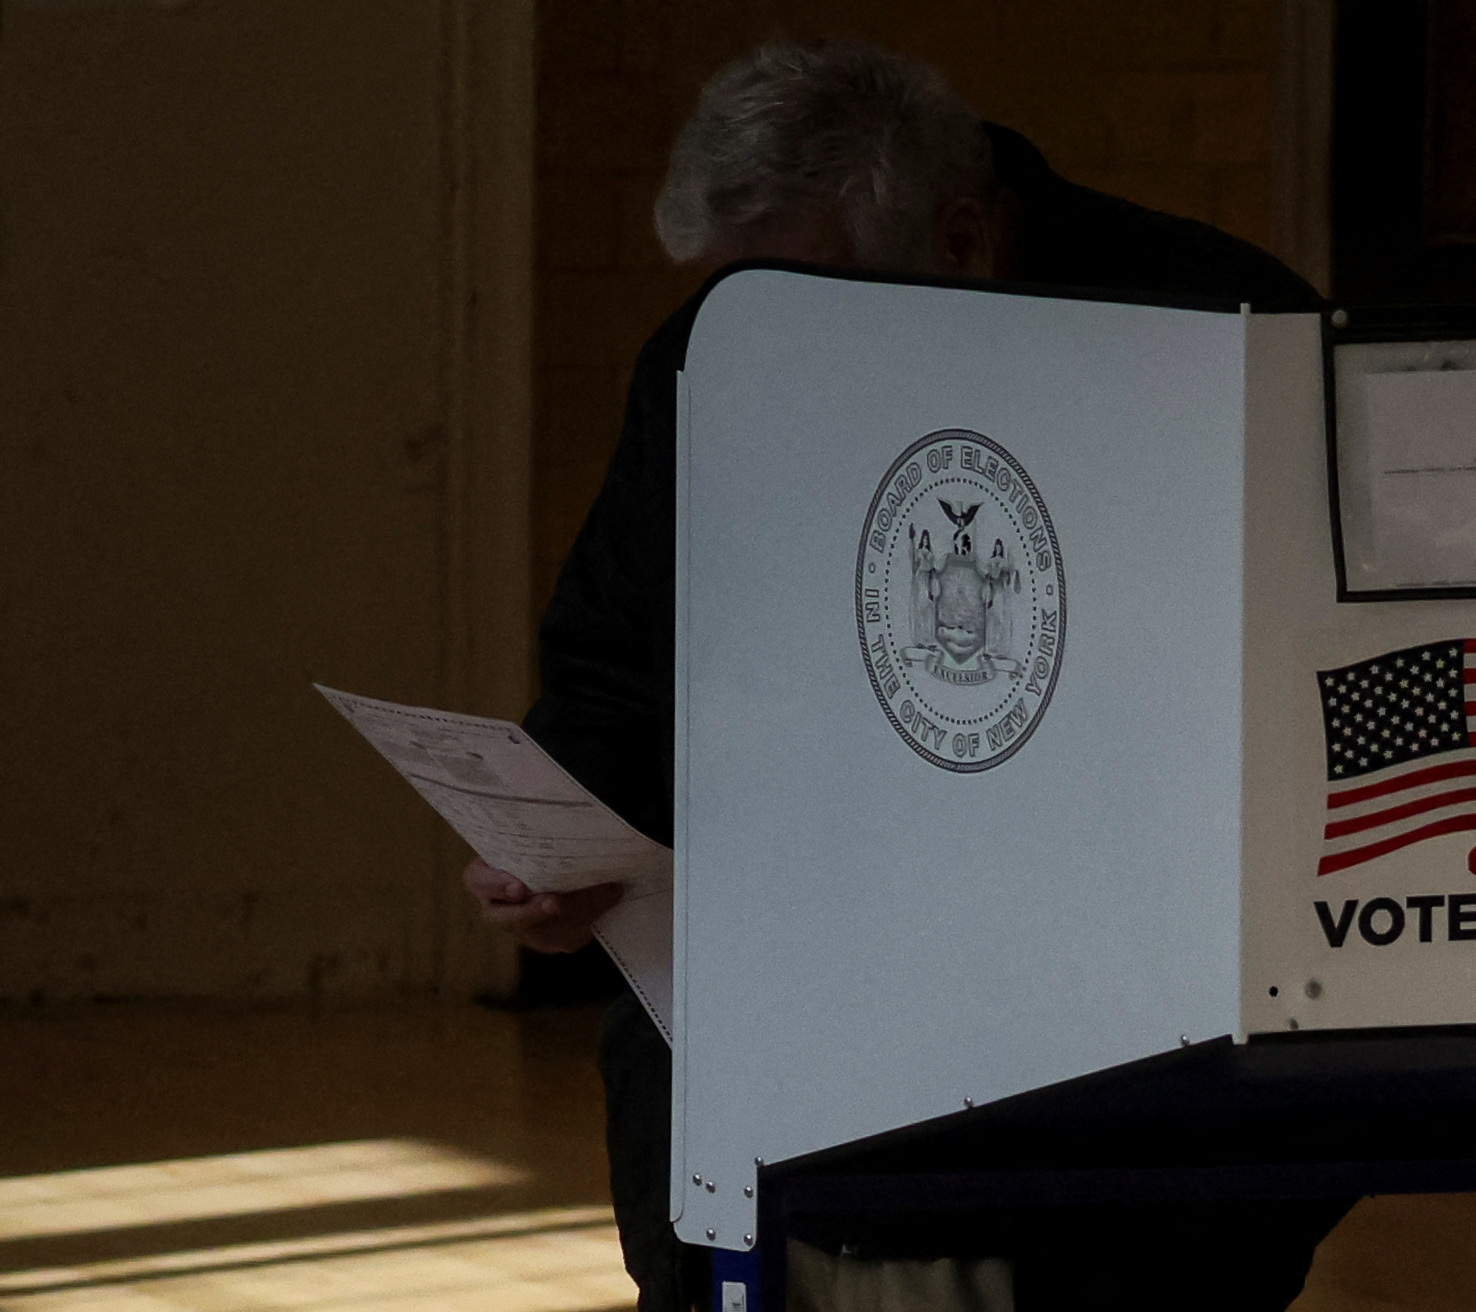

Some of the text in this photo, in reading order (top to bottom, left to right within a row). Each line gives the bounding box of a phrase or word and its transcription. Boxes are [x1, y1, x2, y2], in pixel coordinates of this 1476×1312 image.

[870, 445, 1053, 573] BOARD OF ELECTIONS
[865, 587, 1058, 758] IN THE CITY OF NEW YORK
